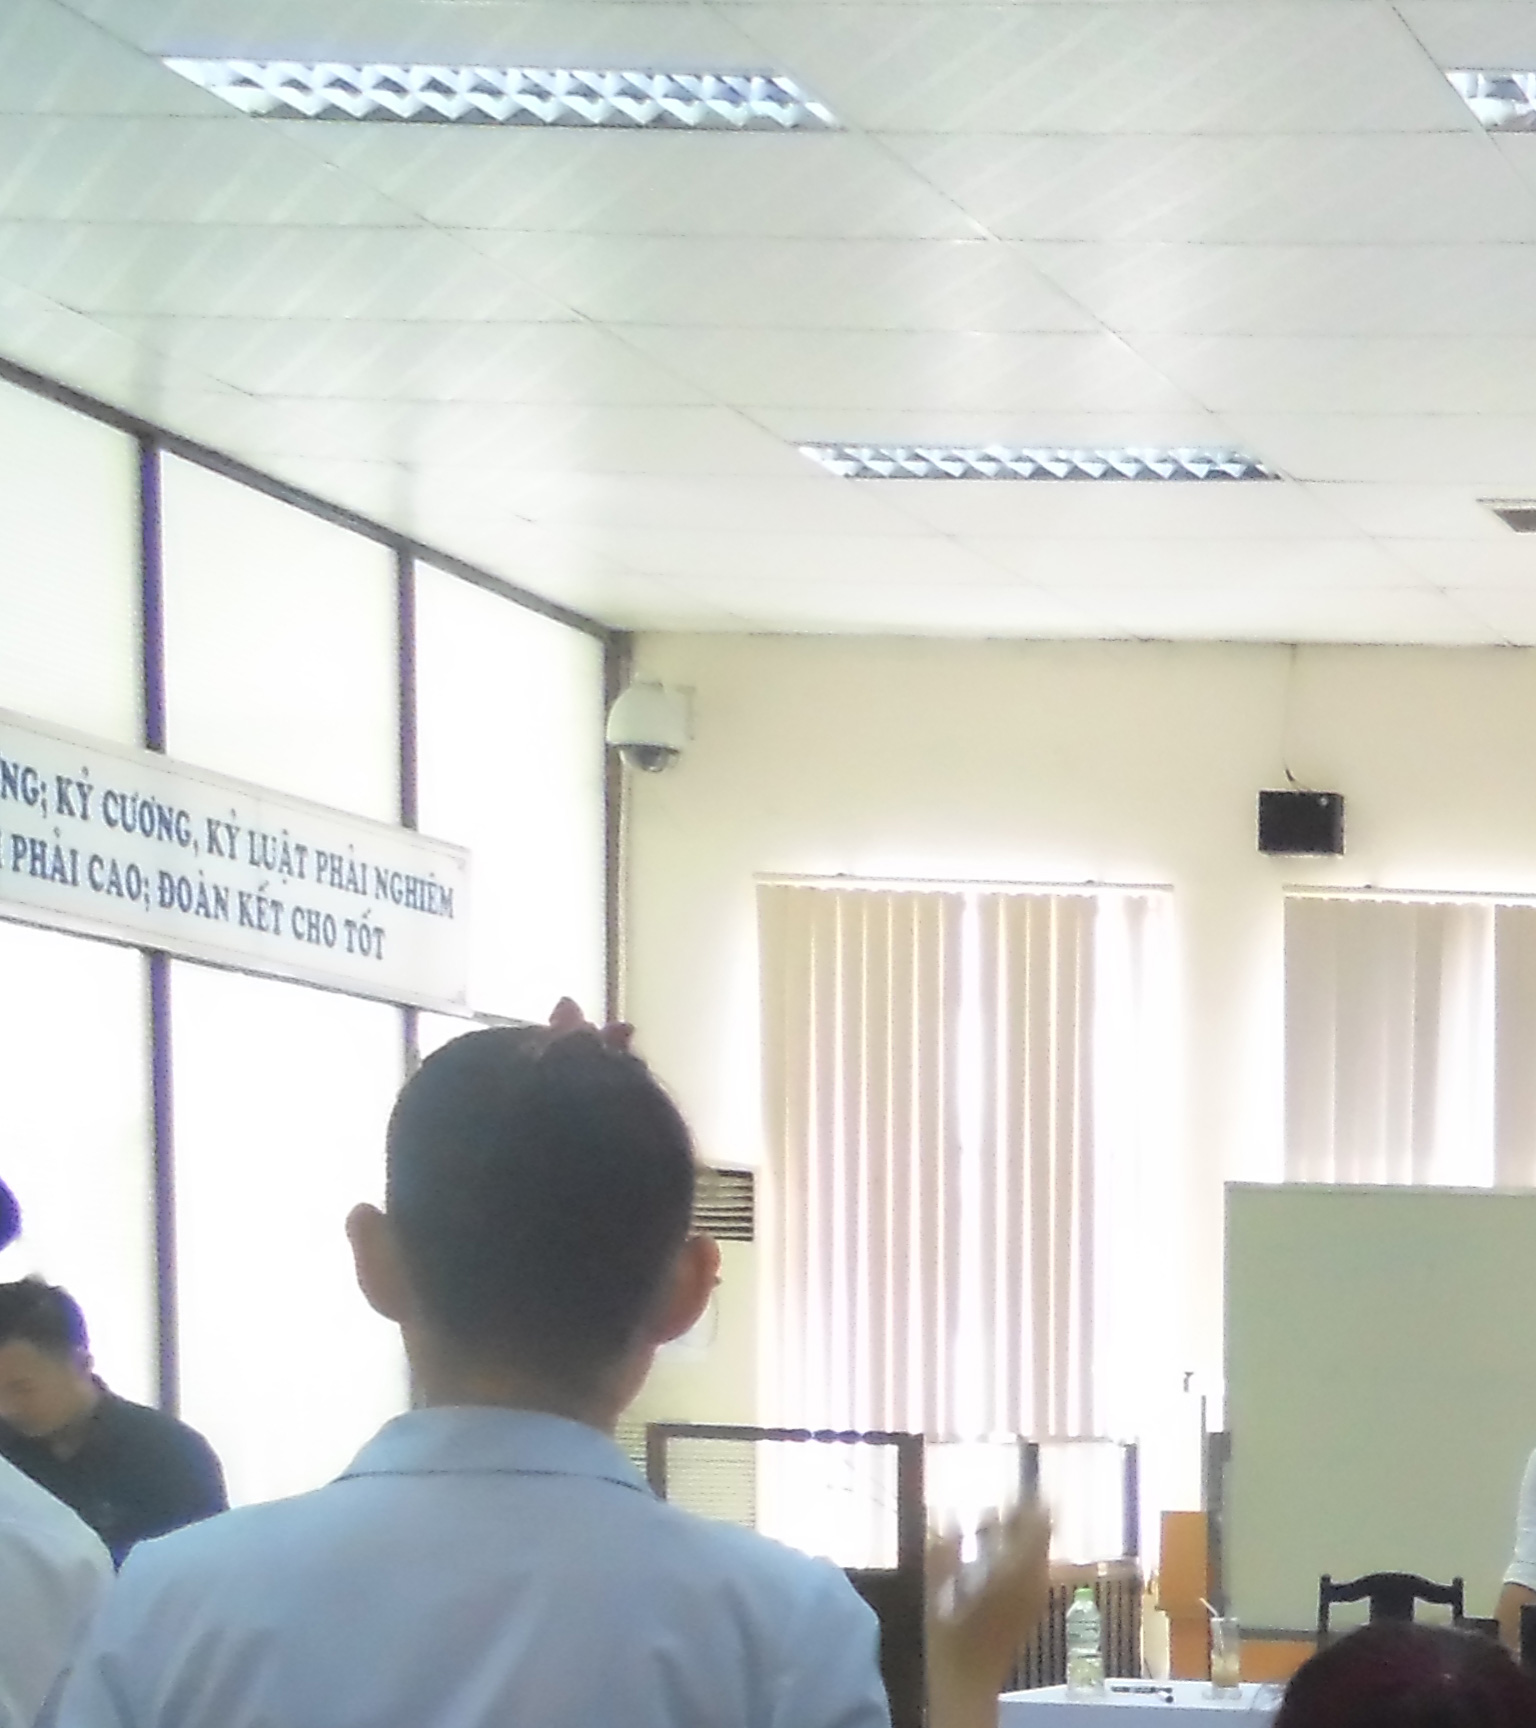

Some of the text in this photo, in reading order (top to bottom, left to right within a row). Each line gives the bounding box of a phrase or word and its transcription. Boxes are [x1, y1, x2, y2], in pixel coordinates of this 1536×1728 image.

[0, 760, 47, 819] NG;
[247, 828, 309, 886] LUẬT
[373, 871, 455, 921] NGHIÊM
[11, 827, 79, 888] PHẢI
[87, 853, 151, 913] CAO;
[157, 869, 230, 923] ĐOÀN
[237, 880, 284, 937] KẾT
[291, 905, 338, 950] CHO
[343, 907, 387, 962] TỐT
